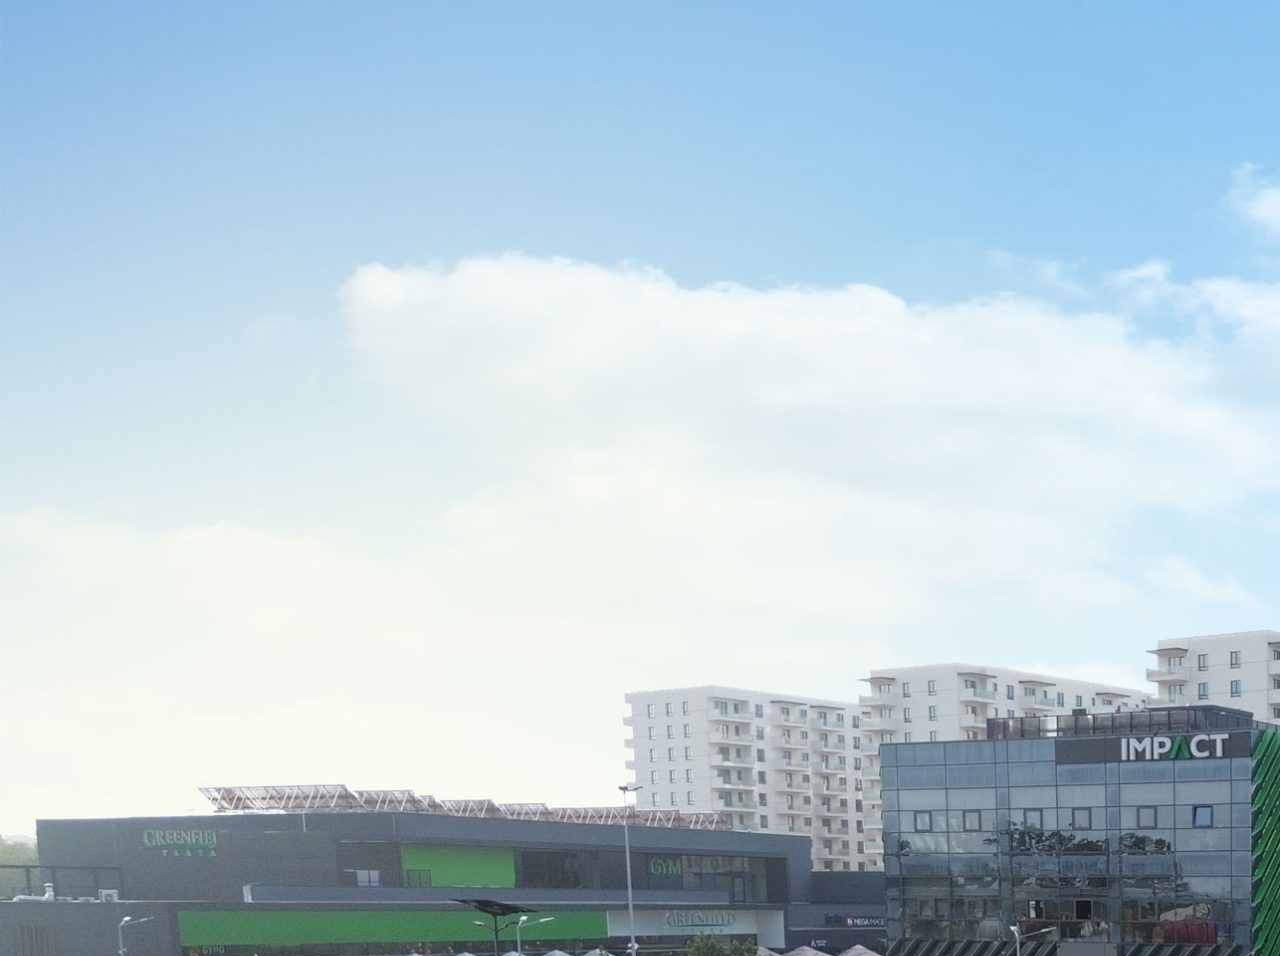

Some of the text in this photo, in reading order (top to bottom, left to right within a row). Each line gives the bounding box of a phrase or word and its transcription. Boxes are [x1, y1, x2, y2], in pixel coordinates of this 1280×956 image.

[1121, 733, 1230, 761] IMPACT
[650, 857, 681, 875] GYM
[853, 917, 885, 926] MEGA IMAGE
